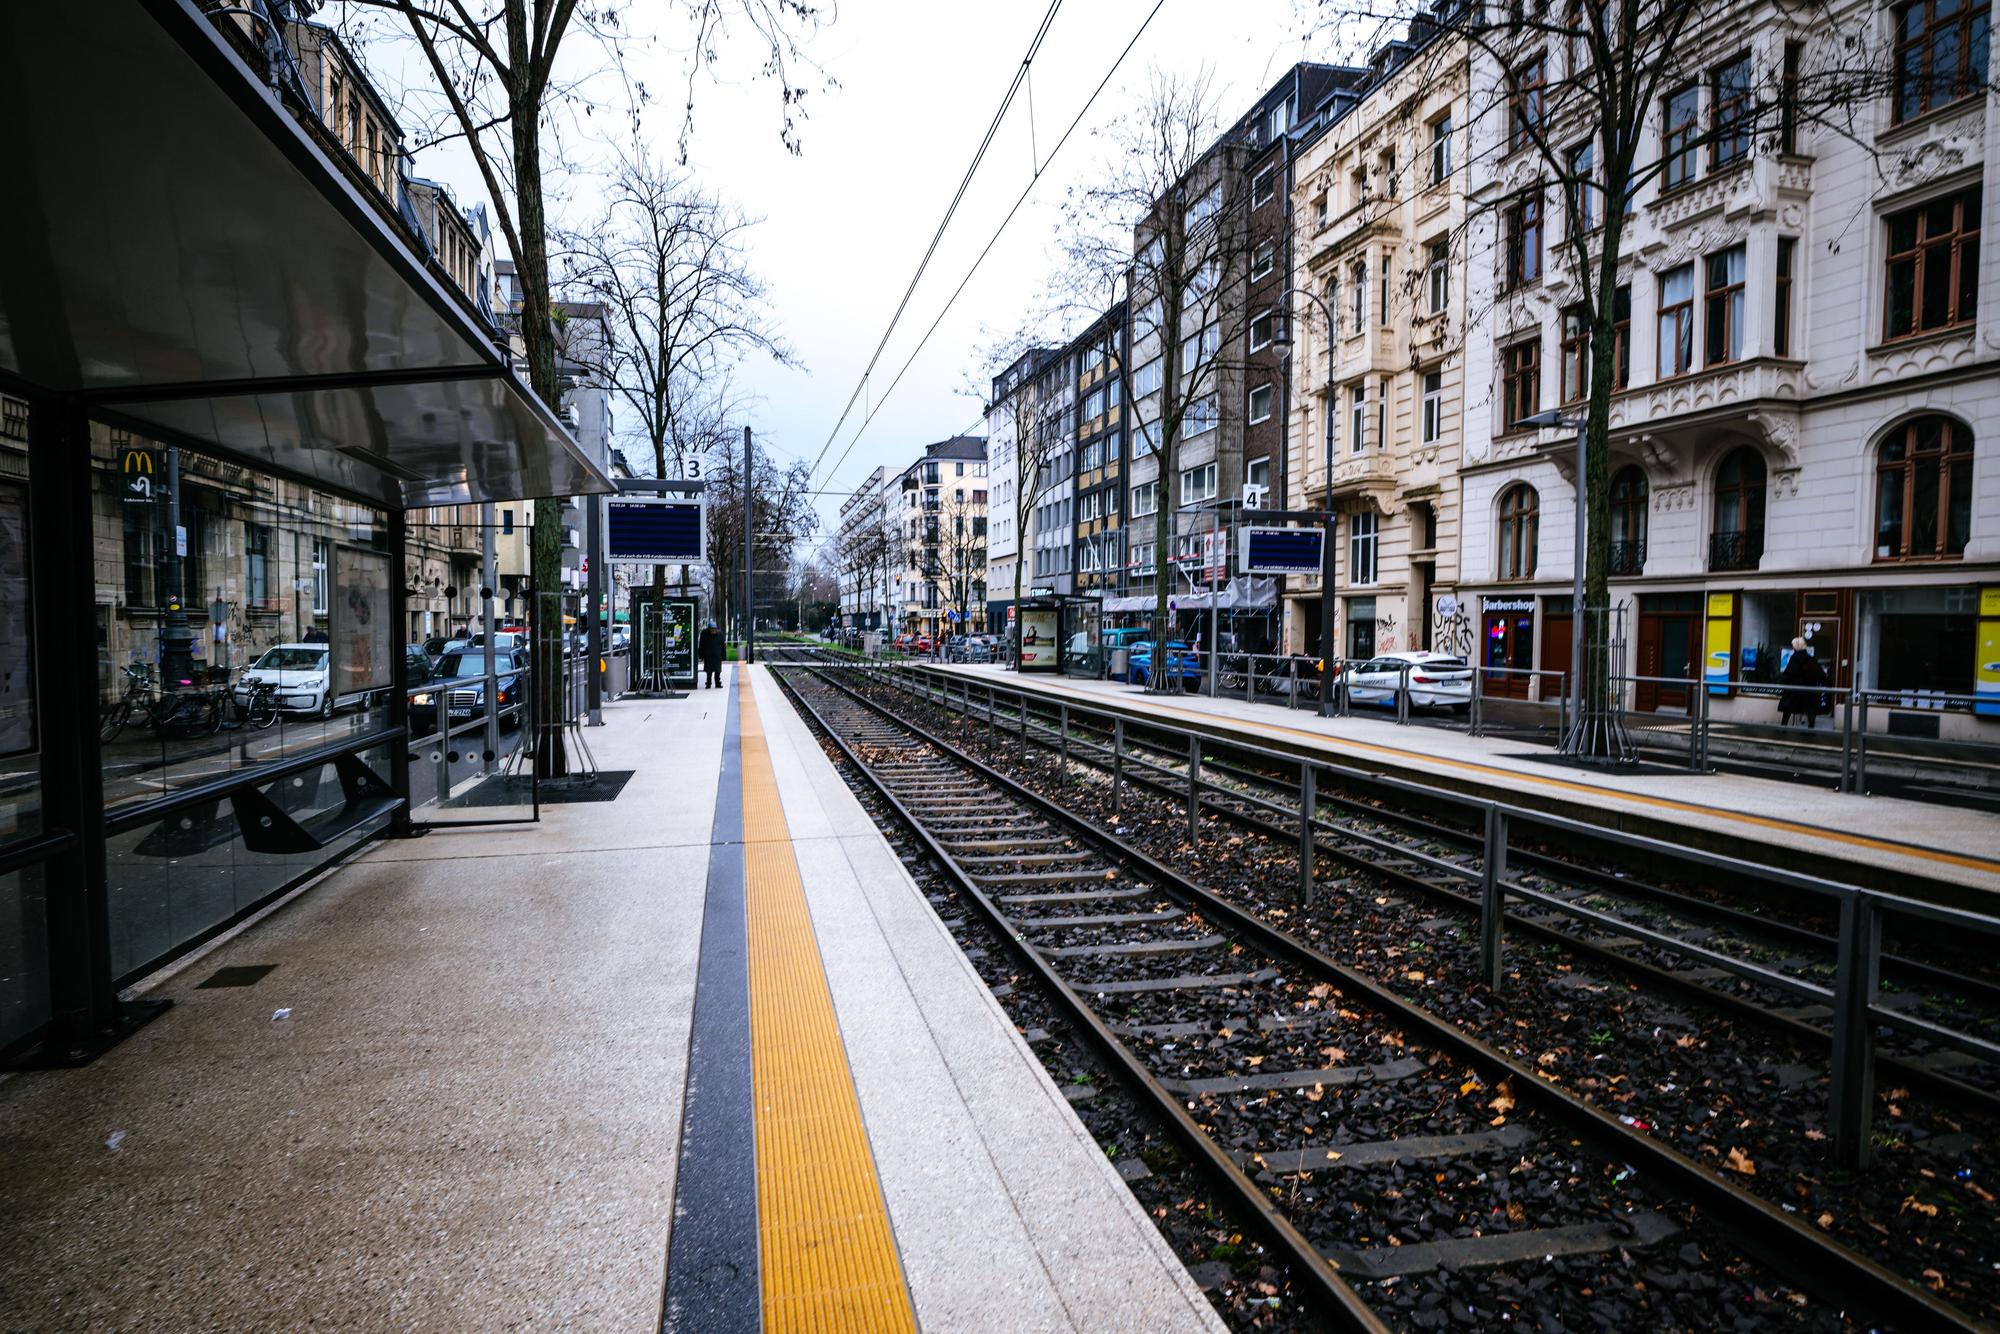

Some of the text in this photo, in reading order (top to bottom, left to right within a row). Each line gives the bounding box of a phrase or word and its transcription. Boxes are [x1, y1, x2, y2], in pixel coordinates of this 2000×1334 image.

[688, 460, 701, 478] 3
[1246, 492, 1257, 507] 4
[1483, 598, 1535, 613] Barbershop
